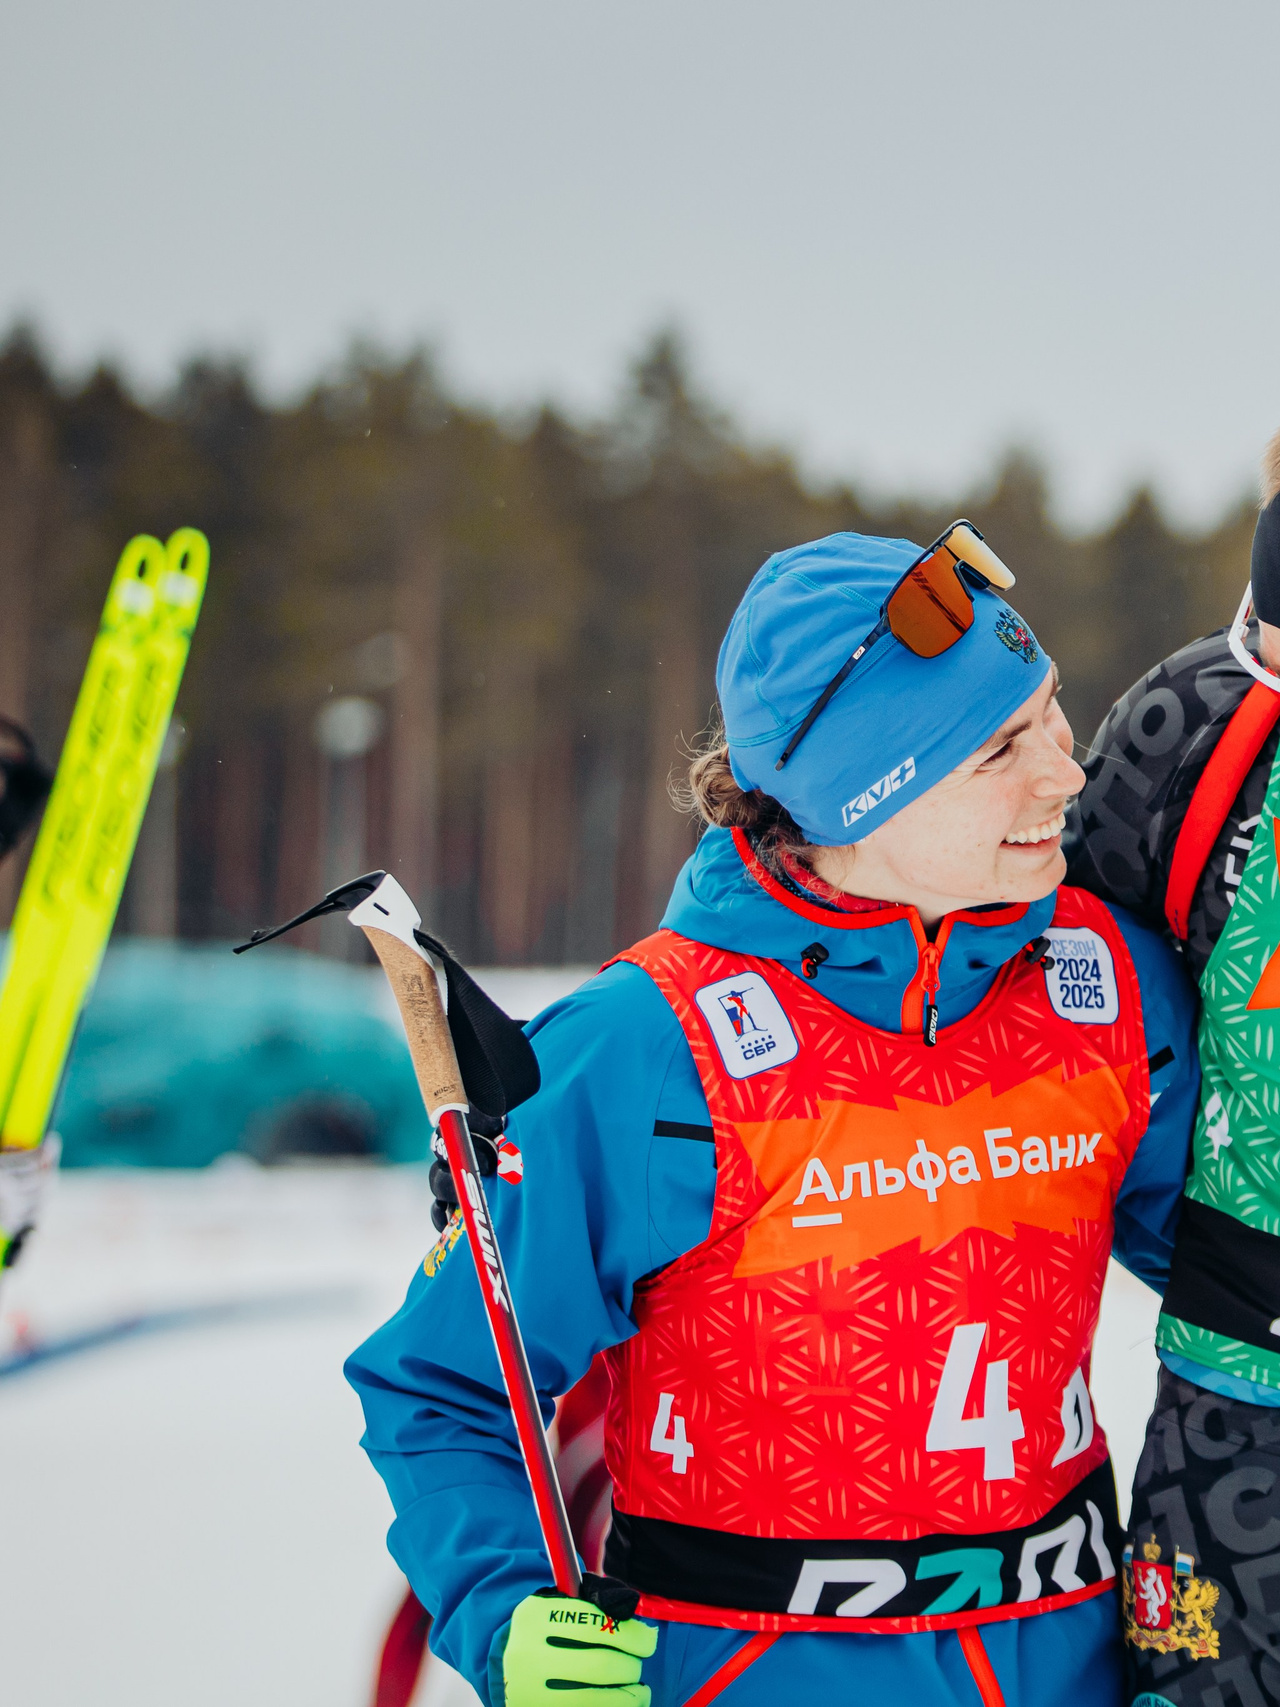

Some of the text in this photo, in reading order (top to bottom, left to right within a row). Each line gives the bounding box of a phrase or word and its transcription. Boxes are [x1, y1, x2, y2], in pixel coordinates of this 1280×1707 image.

[1051, 939, 1098, 957] СЕЗОН
[1056, 957, 1102, 982] 2024
[1060, 983, 1105, 1009] 2025
[743, 1040, 776, 1060] СБР
[792, 1127, 1103, 1203] Альфа Банк
[926, 1322, 1025, 1481] 4
[650, 1392, 694, 1474] 4
